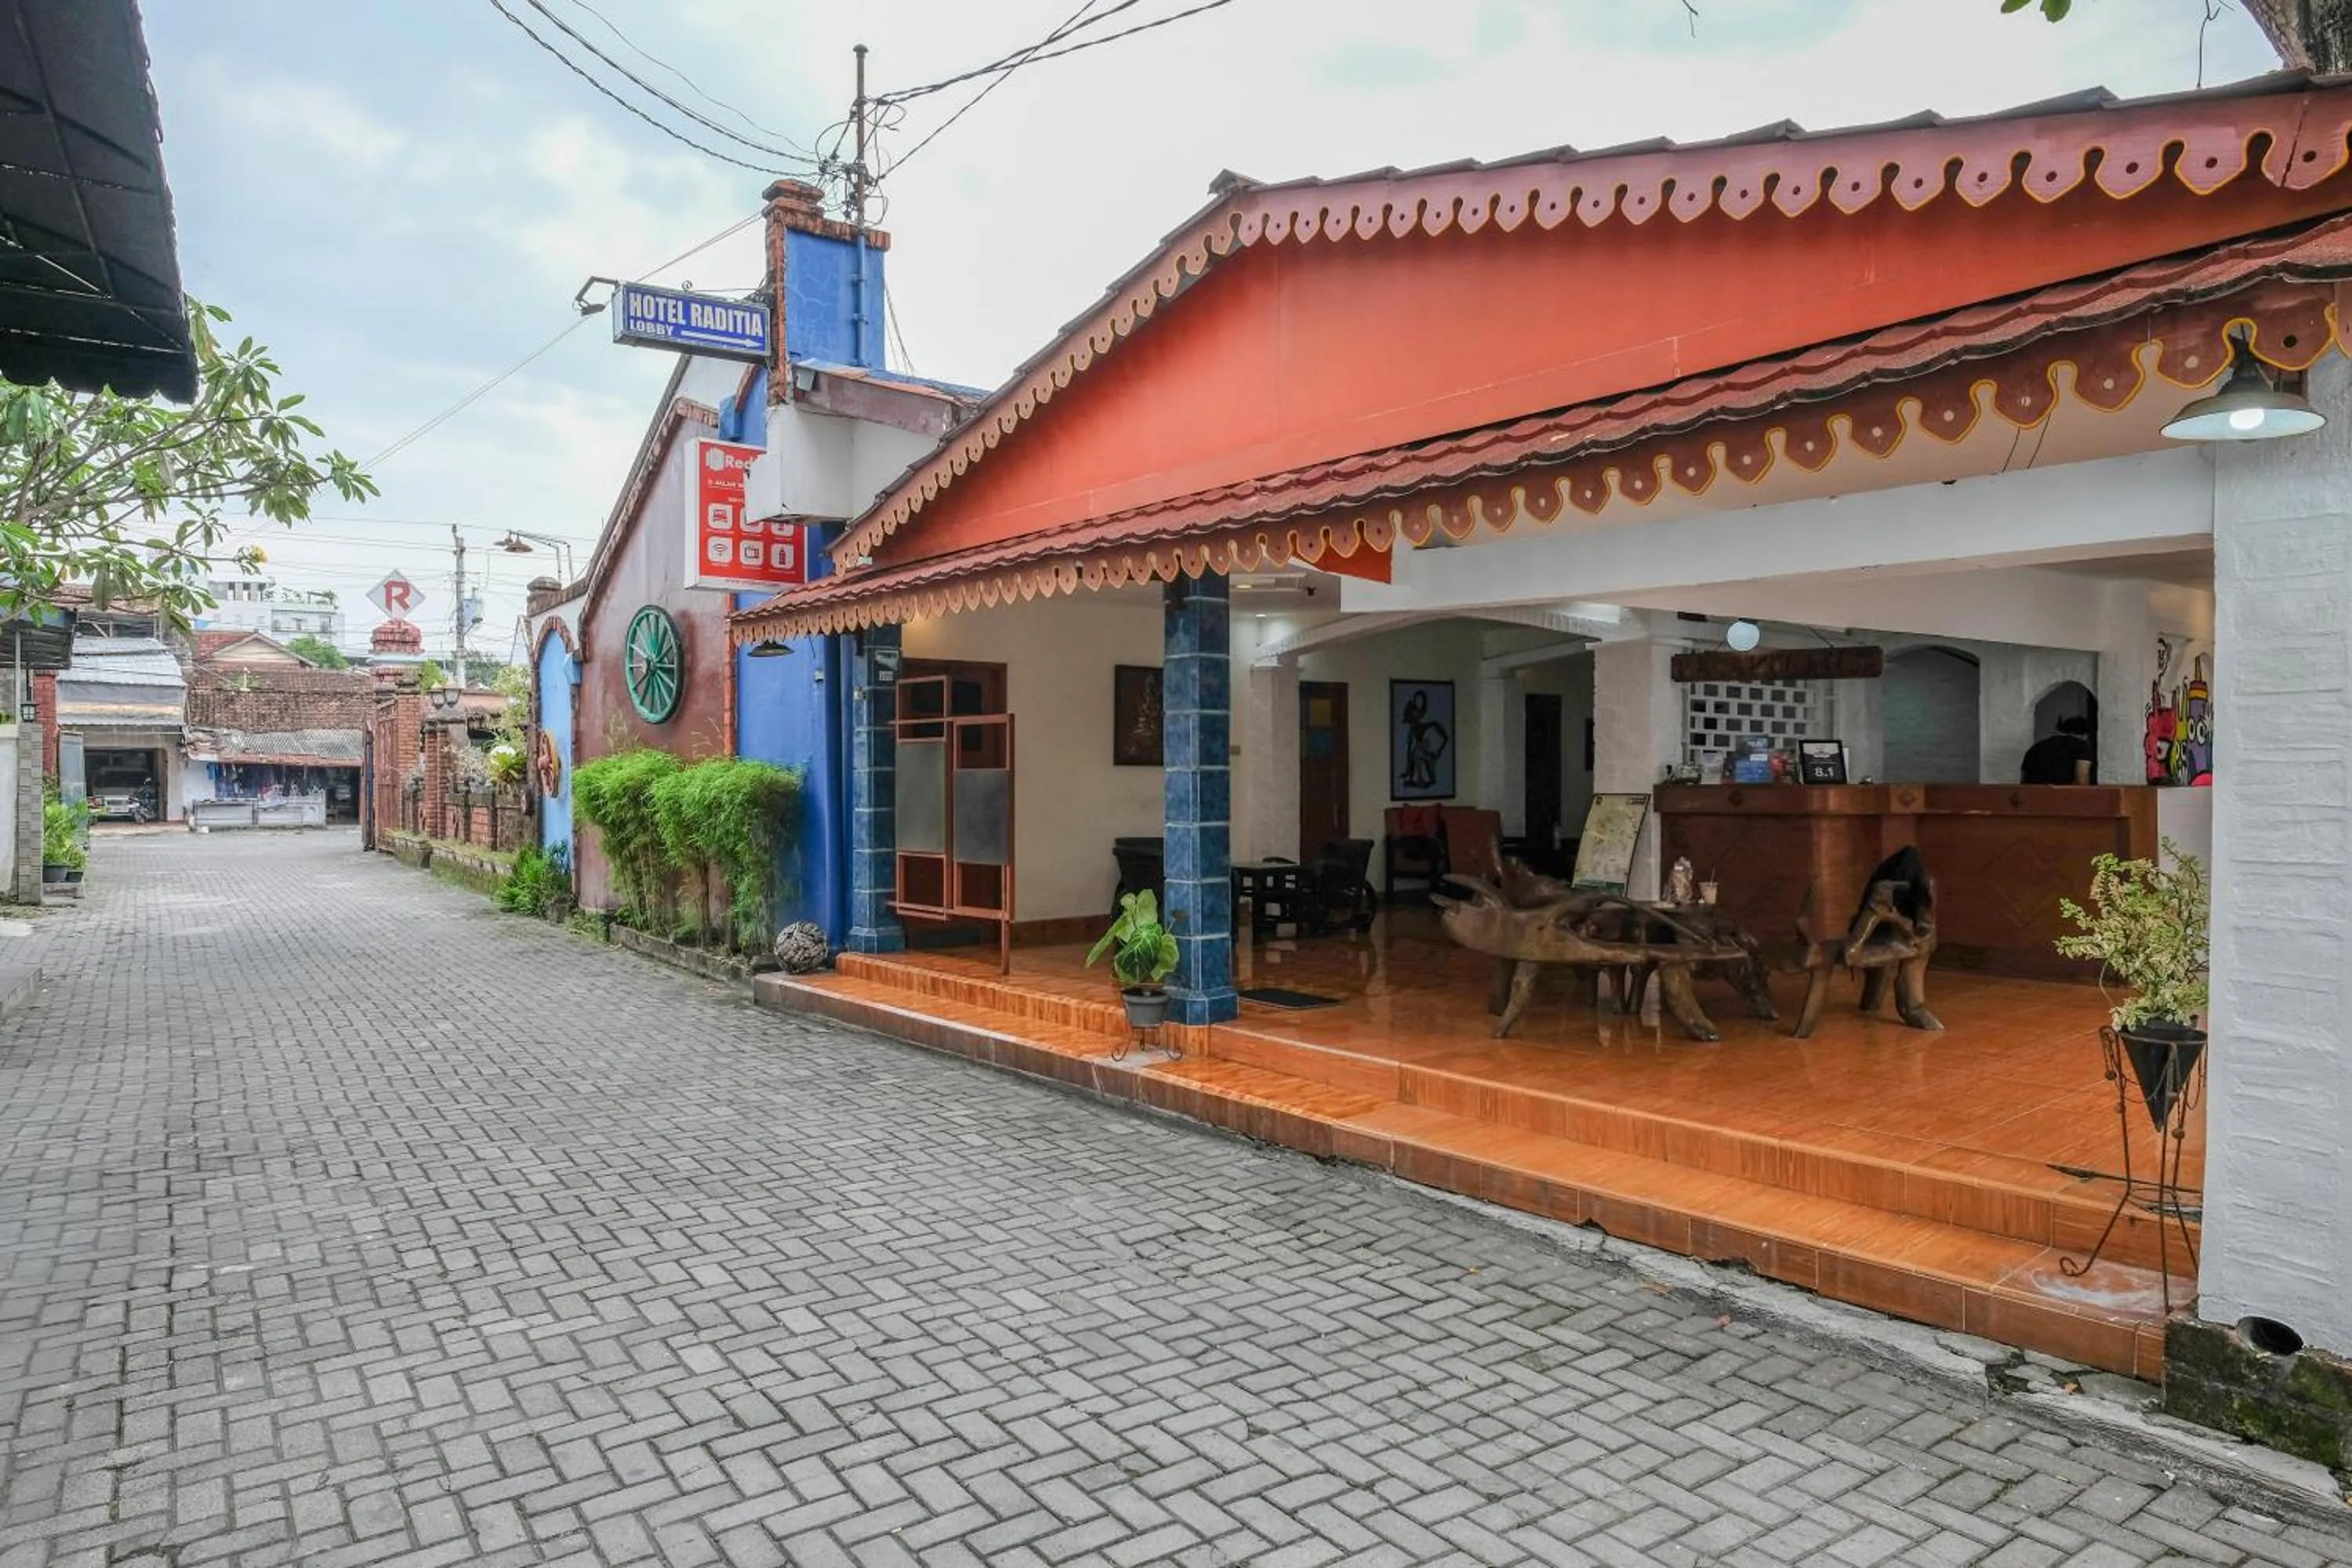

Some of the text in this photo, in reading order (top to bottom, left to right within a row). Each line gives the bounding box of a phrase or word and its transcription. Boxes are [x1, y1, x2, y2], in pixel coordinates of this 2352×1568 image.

[629, 292, 764, 337] HOTEL RADITIA
[630, 318, 674, 336] LOBBY
[725, 454, 754, 469] Red
[383, 580, 410, 612] R
